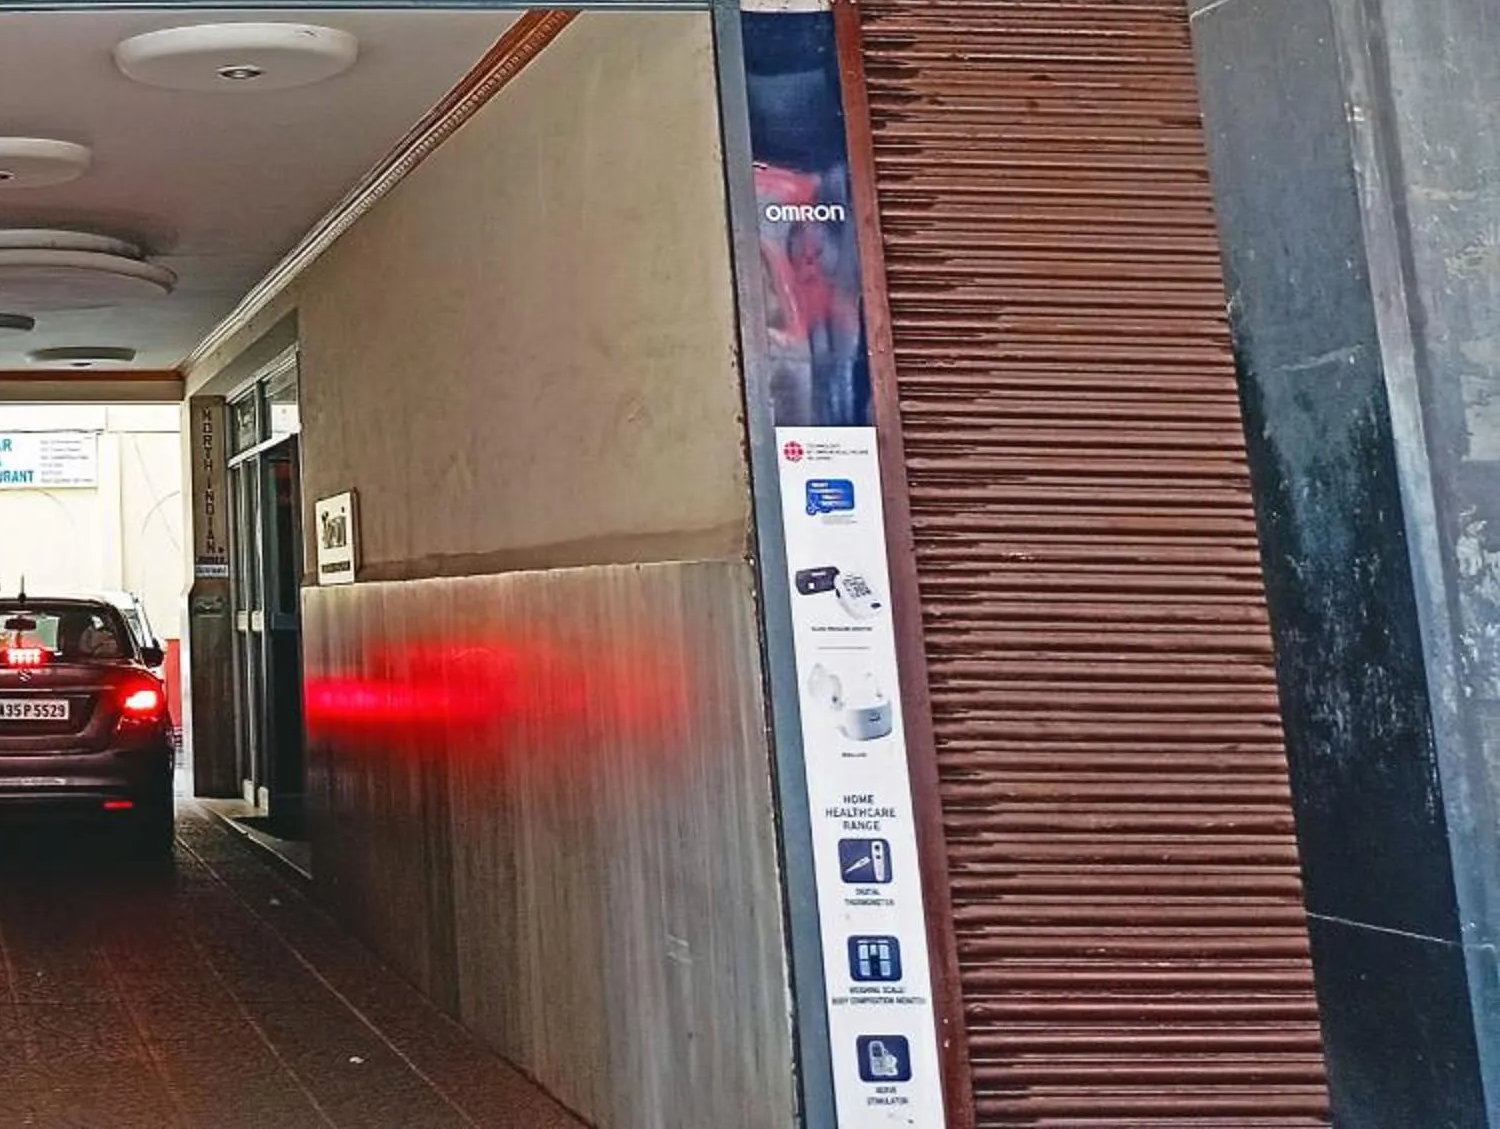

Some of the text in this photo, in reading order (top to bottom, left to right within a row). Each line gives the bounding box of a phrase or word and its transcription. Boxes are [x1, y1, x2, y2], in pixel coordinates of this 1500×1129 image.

[843, 794, 875, 805] HOME
[825, 807, 897, 819] HEALTHCARE
[843, 820, 881, 831] RANGE
